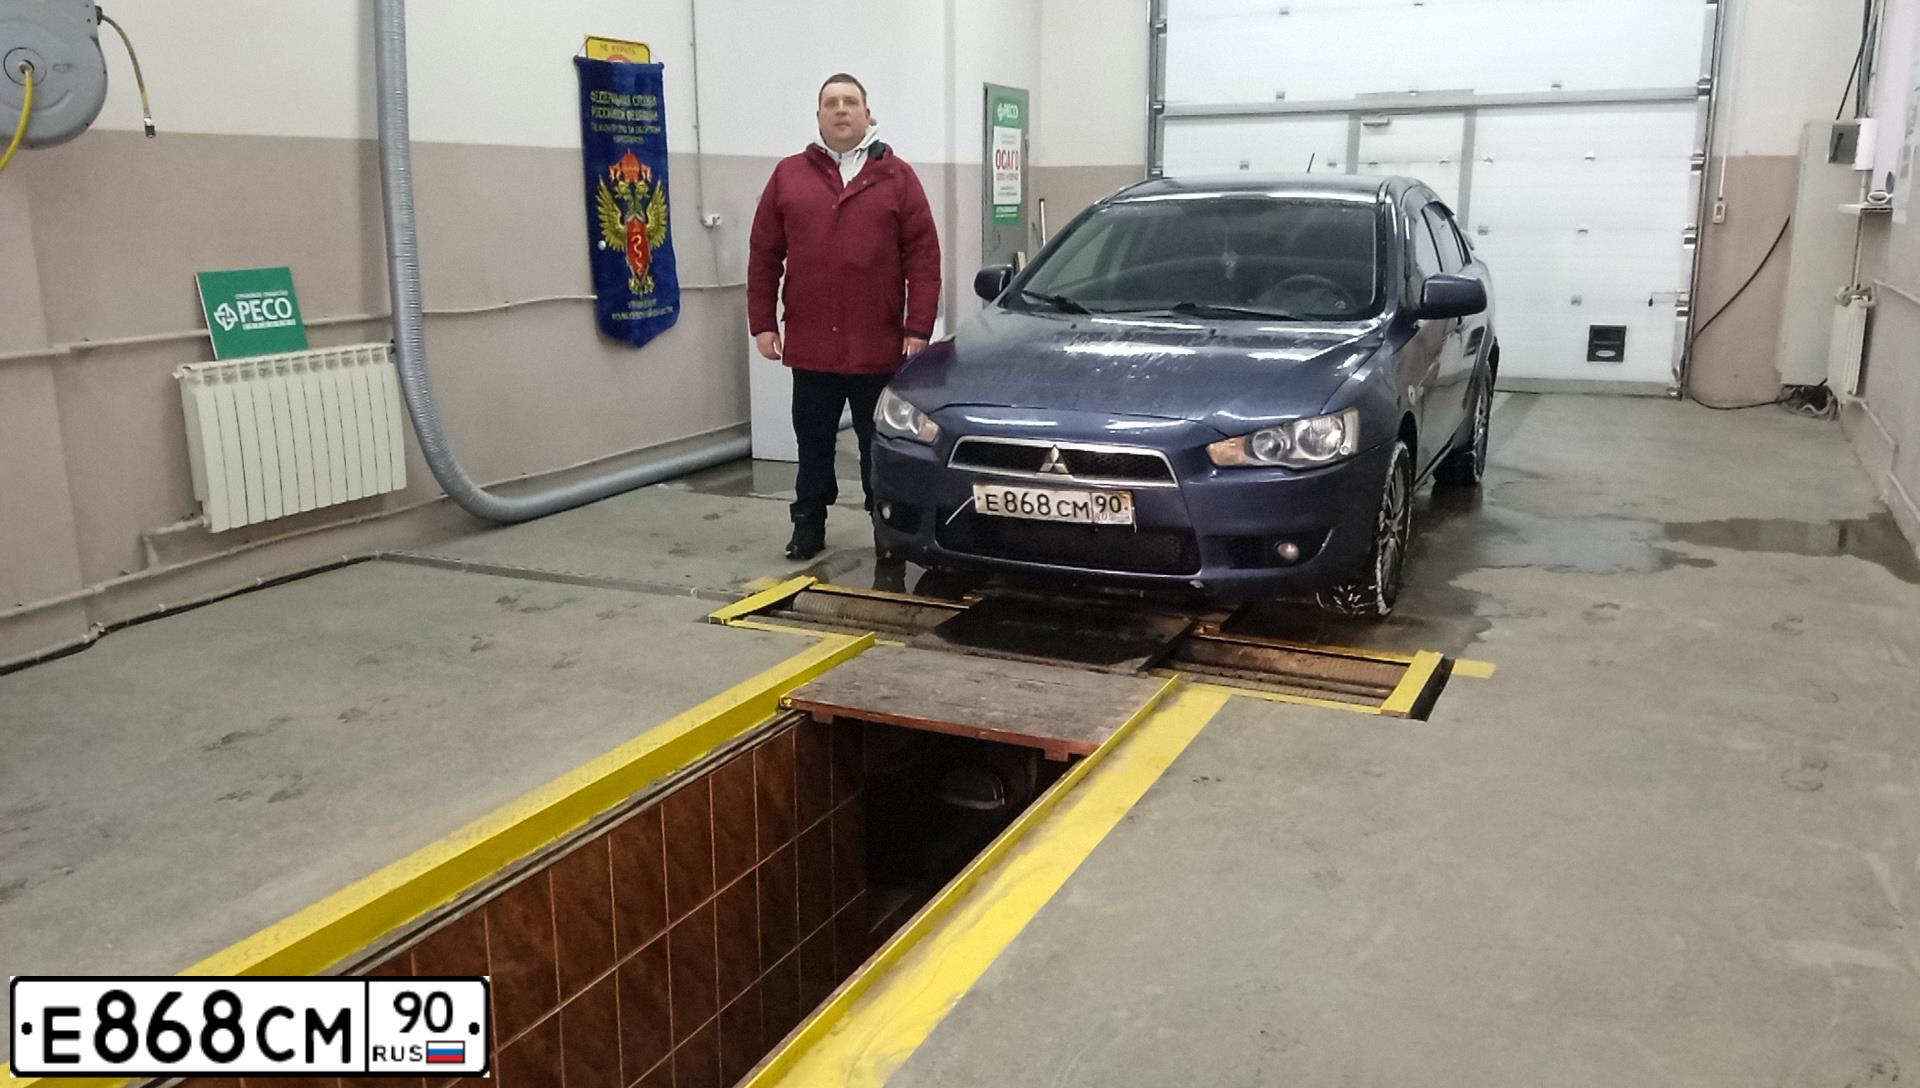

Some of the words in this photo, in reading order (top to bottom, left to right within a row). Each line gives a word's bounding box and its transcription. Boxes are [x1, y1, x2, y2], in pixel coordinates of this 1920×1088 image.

[995, 149, 1019, 171] ОСАГО
[236, 297, 292, 322] РЕСО
[1095, 495, 1122, 513] 90
